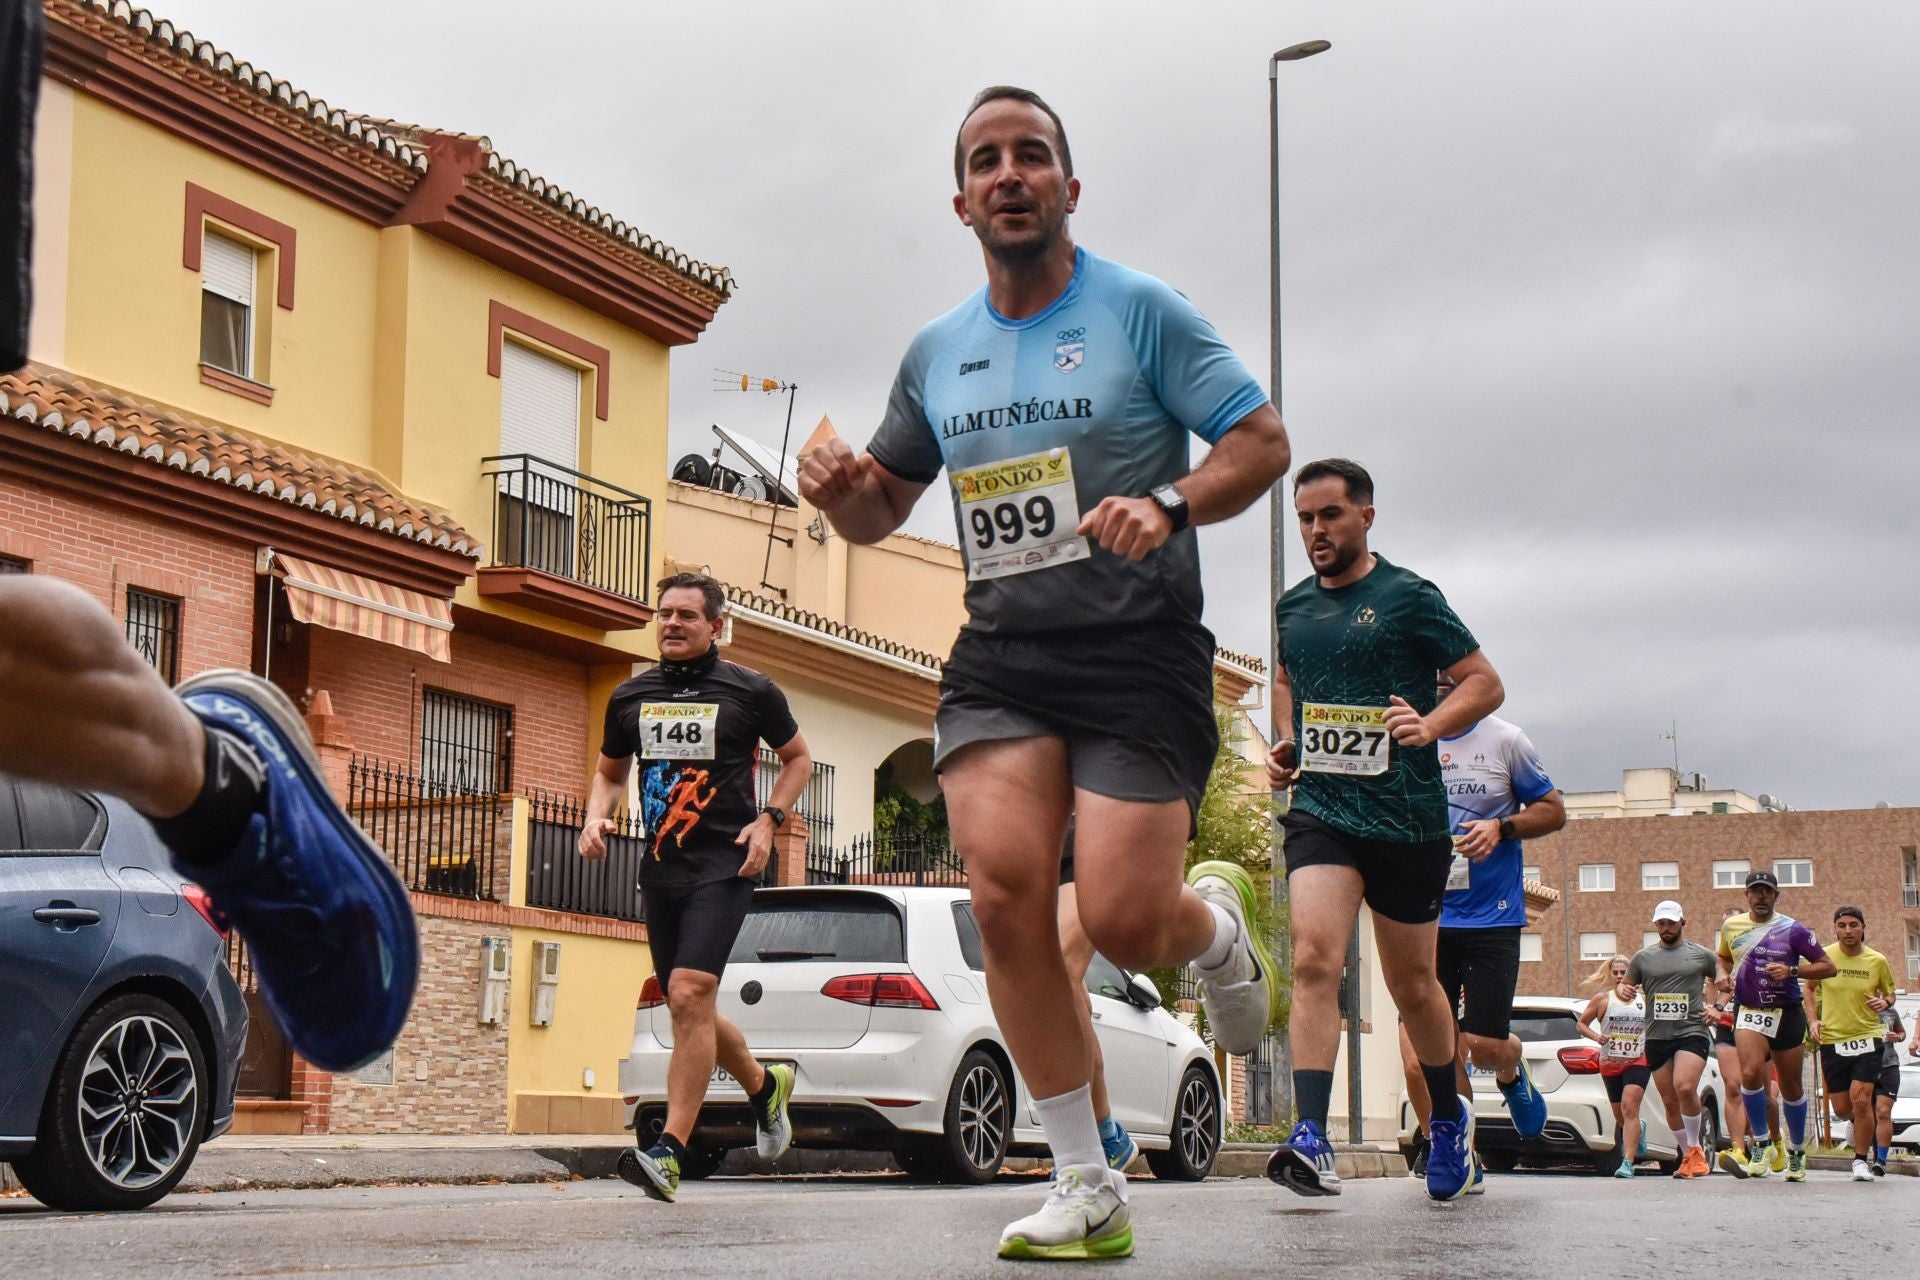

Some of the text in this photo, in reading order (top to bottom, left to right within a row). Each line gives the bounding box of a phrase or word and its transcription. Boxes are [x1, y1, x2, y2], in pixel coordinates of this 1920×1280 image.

[943, 397, 1093, 440] ALMUÑÉCAR
[975, 467, 1043, 494] FONDO
[971, 495, 1055, 549] 999
[652, 706, 663, 716] 38
[662, 709, 701, 717] FONDO
[1312, 708, 1326, 720] 38
[1325, 712, 1370, 723] FONDO
[651, 722, 702, 744] 148
[1305, 727, 1386, 757] 3027
[1842, 968, 1870, 977] RUNNERS
[1655, 1002, 1688, 1014] 3239
[1743, 1013, 1774, 1028] 836
[1609, 1041, 1640, 1052] 2107
[1841, 1038, 1868, 1050] 103
